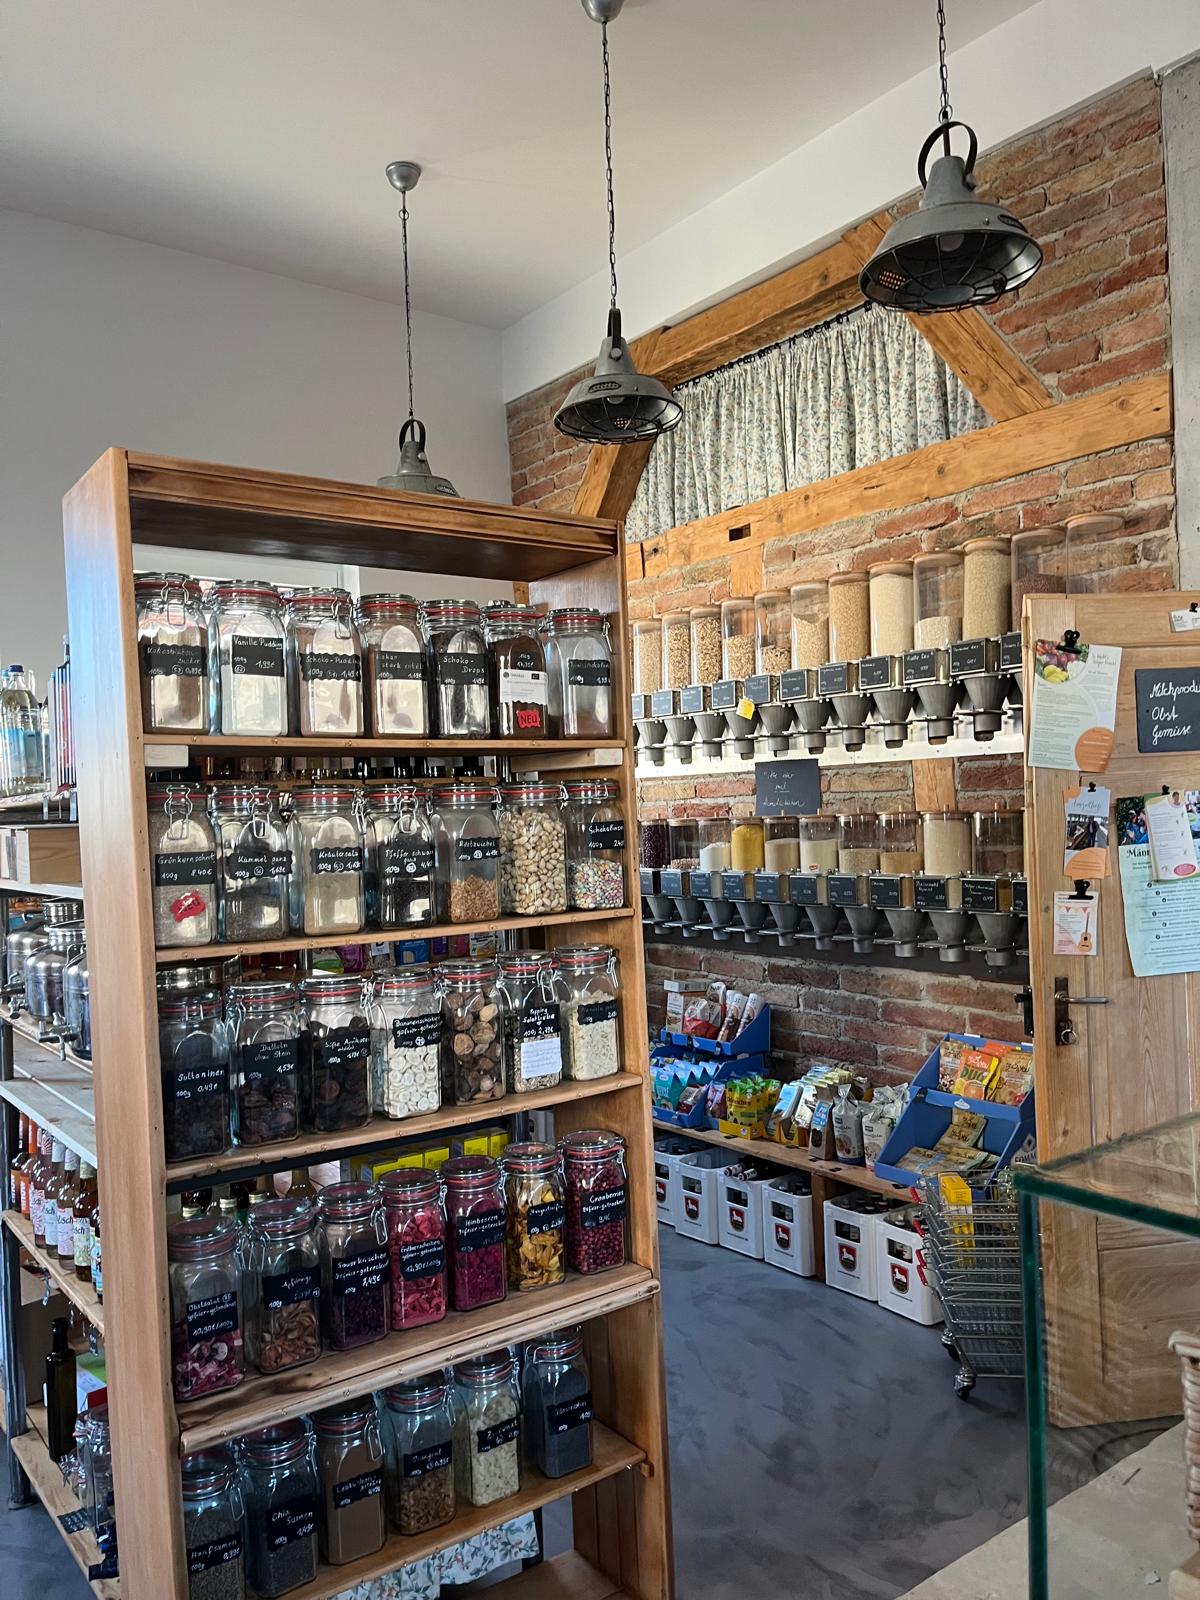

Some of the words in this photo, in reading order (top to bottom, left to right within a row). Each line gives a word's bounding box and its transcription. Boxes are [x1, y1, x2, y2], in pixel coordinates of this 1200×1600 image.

[260, 638, 283, 650] Pudding
[462, 666, 485, 675] Drops
[1151, 705, 1179, 722] Obst
[521, 714, 539, 725] NEU
[1152, 724, 1193, 746] Gemüse
[160, 872, 179, 881] 100g
[234, 870, 251, 879] 100g
[177, 1070, 225, 1082] Sultaninen
[176, 1090, 191, 1099] 100g
[268, 1300, 283, 1309] 100g
[271, 1509, 290, 1522] Chia
